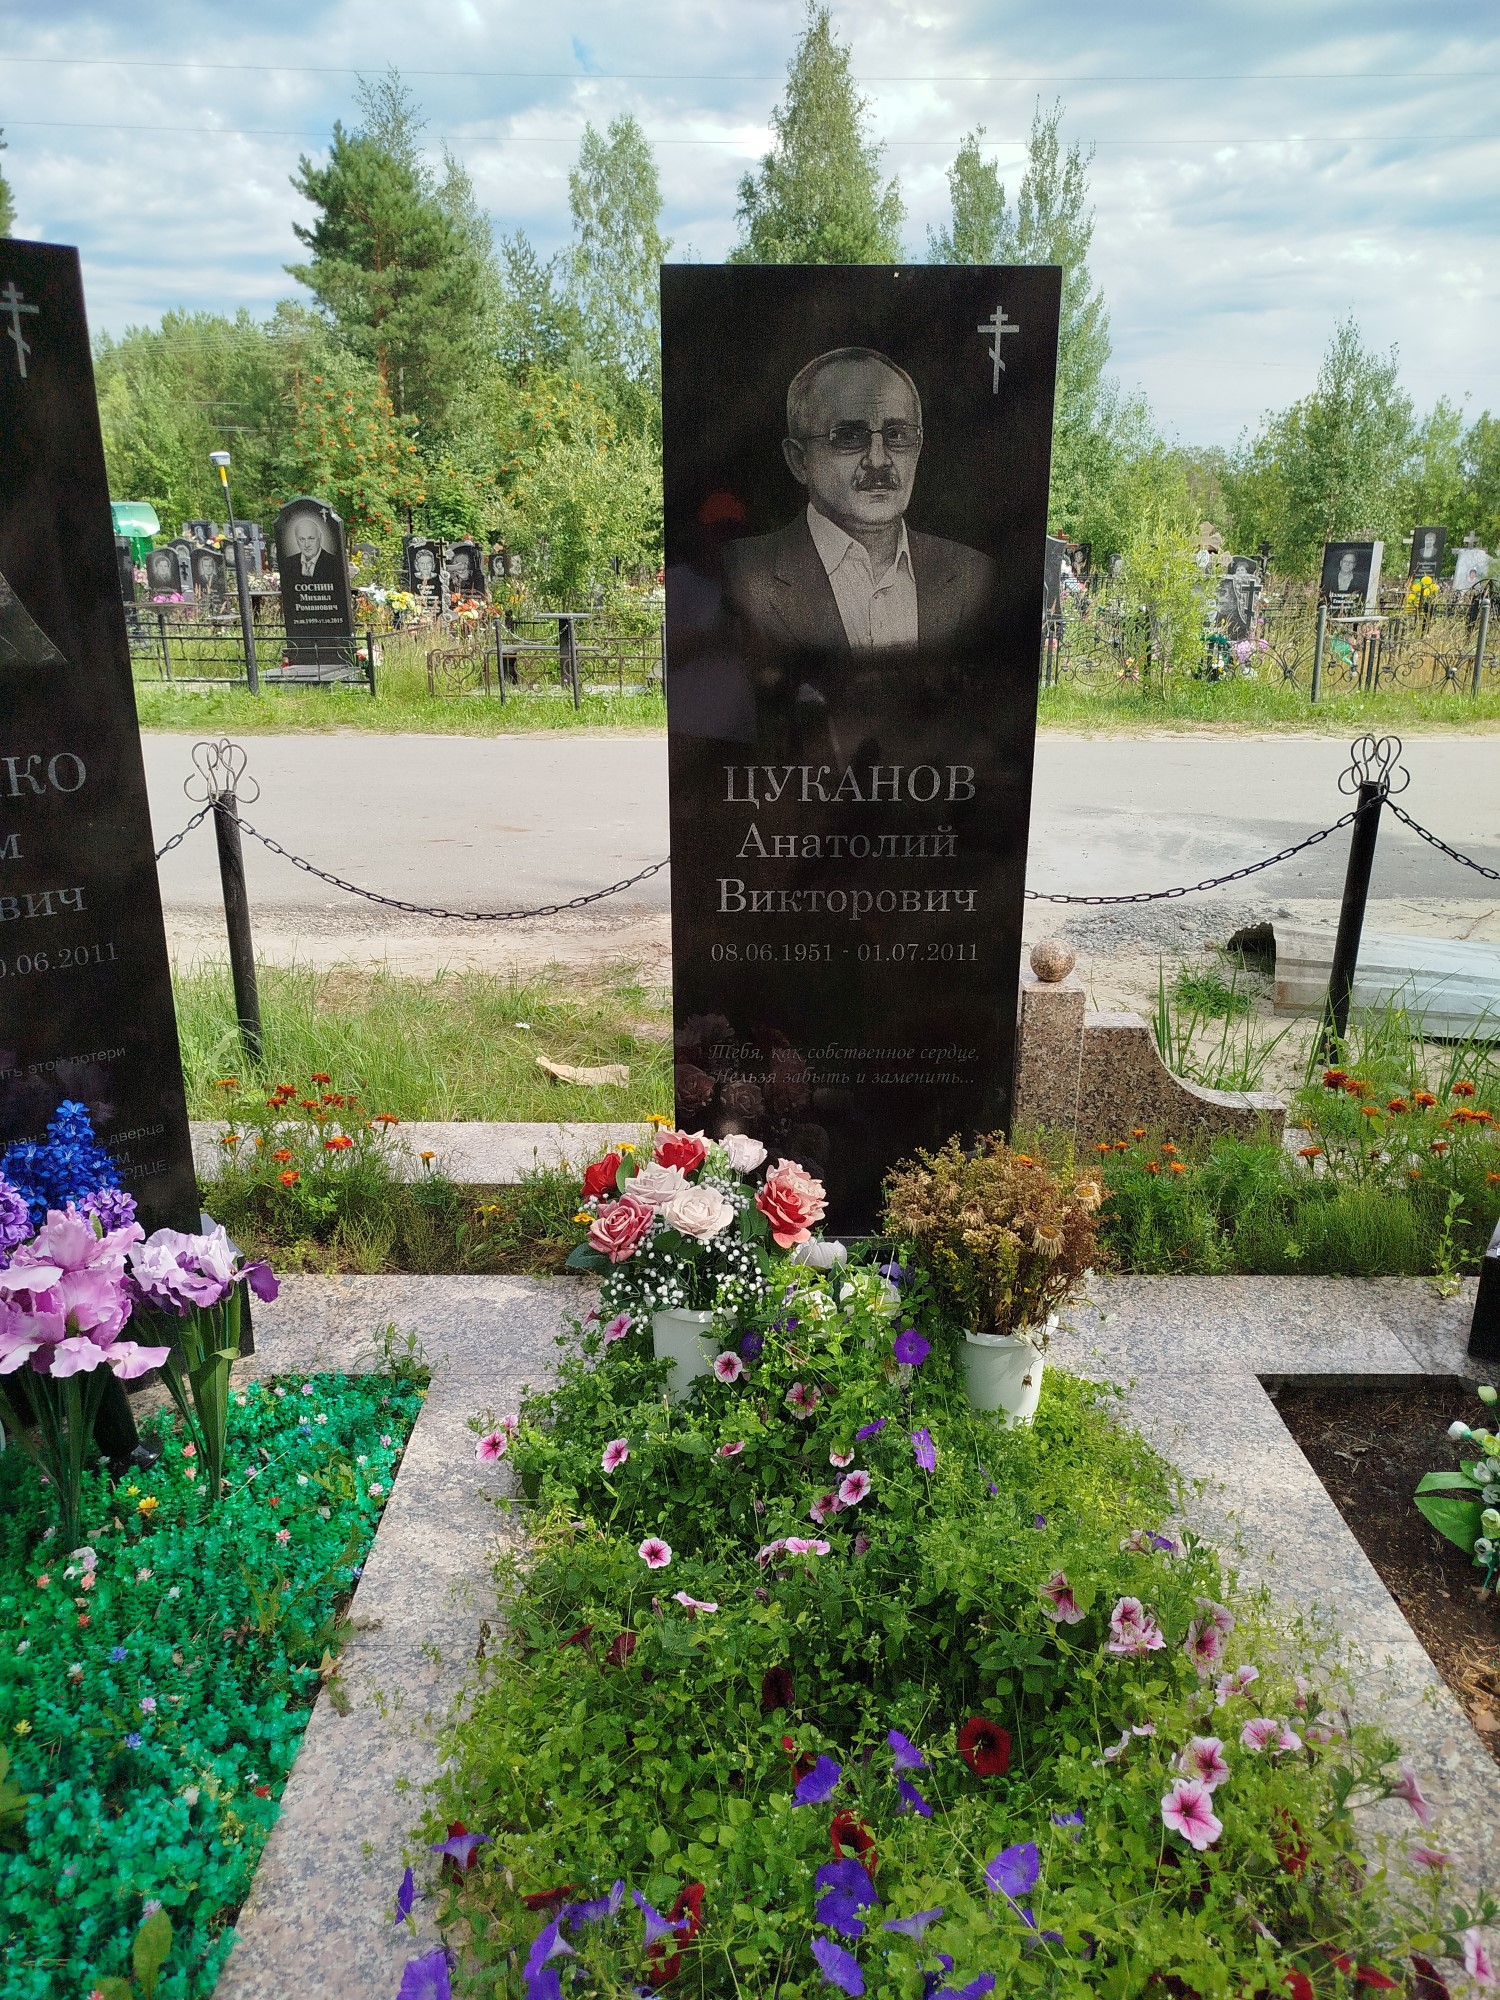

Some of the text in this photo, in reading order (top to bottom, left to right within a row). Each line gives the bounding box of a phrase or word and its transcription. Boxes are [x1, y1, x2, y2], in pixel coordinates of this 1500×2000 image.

[294, 583, 334, 591] СОСНИН
[300, 593, 331, 601] Михаил
[295, 603, 338, 611] Романович
[0, 752, 87, 797] КО
[722, 764, 976, 810] ЦУКАНОВ
[735, 822, 958, 859] Анатолий
[716, 878, 978, 920] Викторович
[710, 943, 834, 963] 08.06.1951
[857, 943, 979, 962] 01.07.2011
[70, 1047, 126, 1066] потери
[708, 1042, 979, 1065] Тебя, как собственное сердце,
[715, 1067, 974, 1084] Нельзя забыть и заменить...
[109, 1123, 165, 1146] дверца
